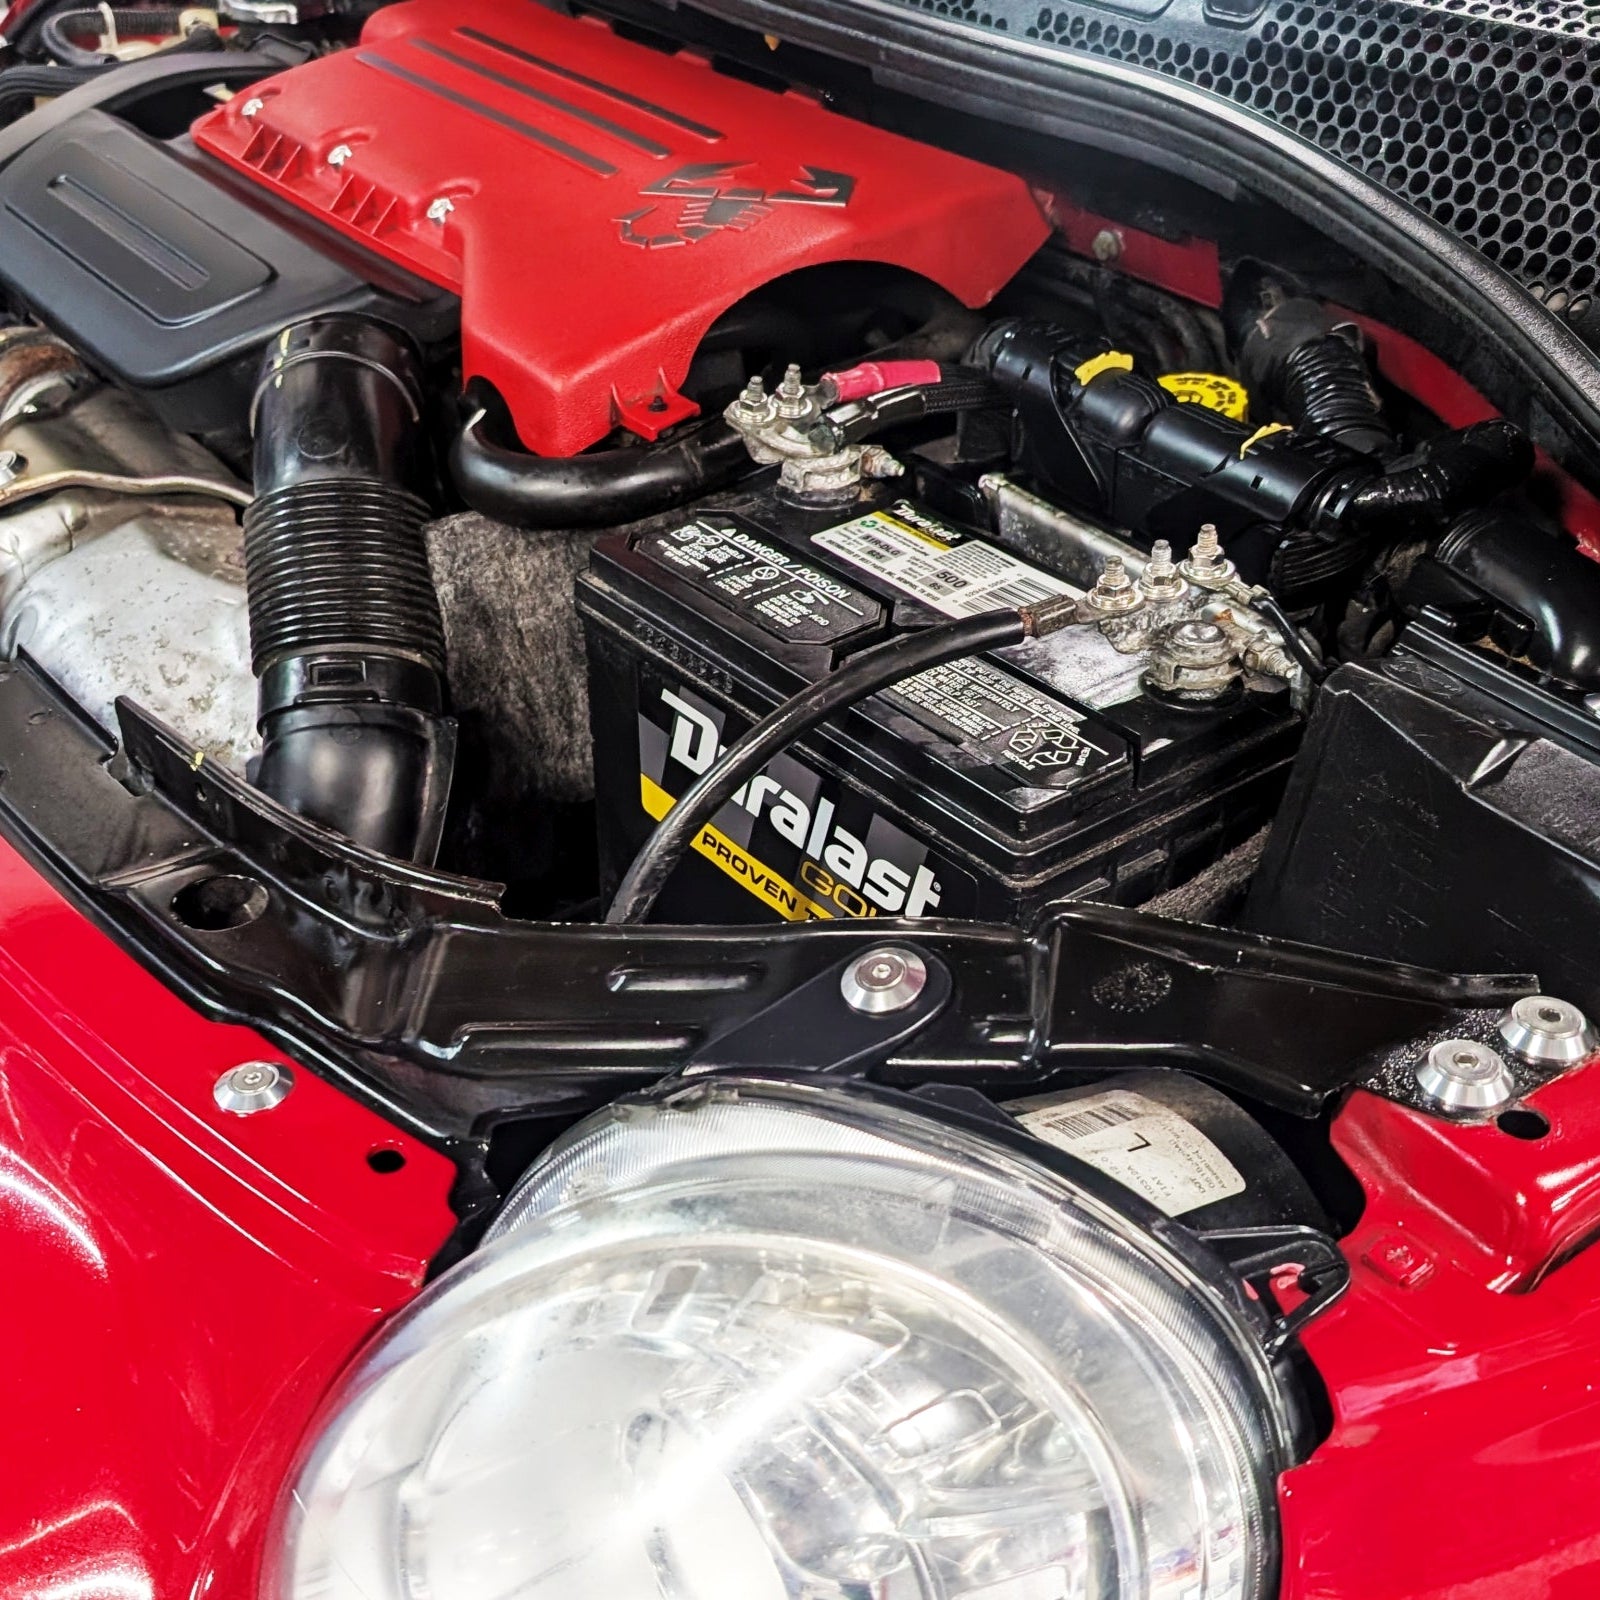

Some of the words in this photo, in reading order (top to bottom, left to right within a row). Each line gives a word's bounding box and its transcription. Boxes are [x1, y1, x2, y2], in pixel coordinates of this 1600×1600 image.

[734, 534, 789, 564] DANGER
[796, 568, 850, 598] POISON
[936, 571, 967, 588] 500
[809, 614, 829, 625] ACID
[948, 673, 970, 685] EYES
[938, 685, 961, 696] HELP
[958, 696, 981, 707] FAST
[963, 690, 982, 699] GET
[1012, 687, 1034, 700] REACH
[1046, 713, 1062, 722] AND
[1001, 750, 1036, 771] RECYCLE
[661, 688, 941, 917] Dralast
[702, 831, 798, 912] PROVEN
[1128, 1133, 1151, 1152] L
